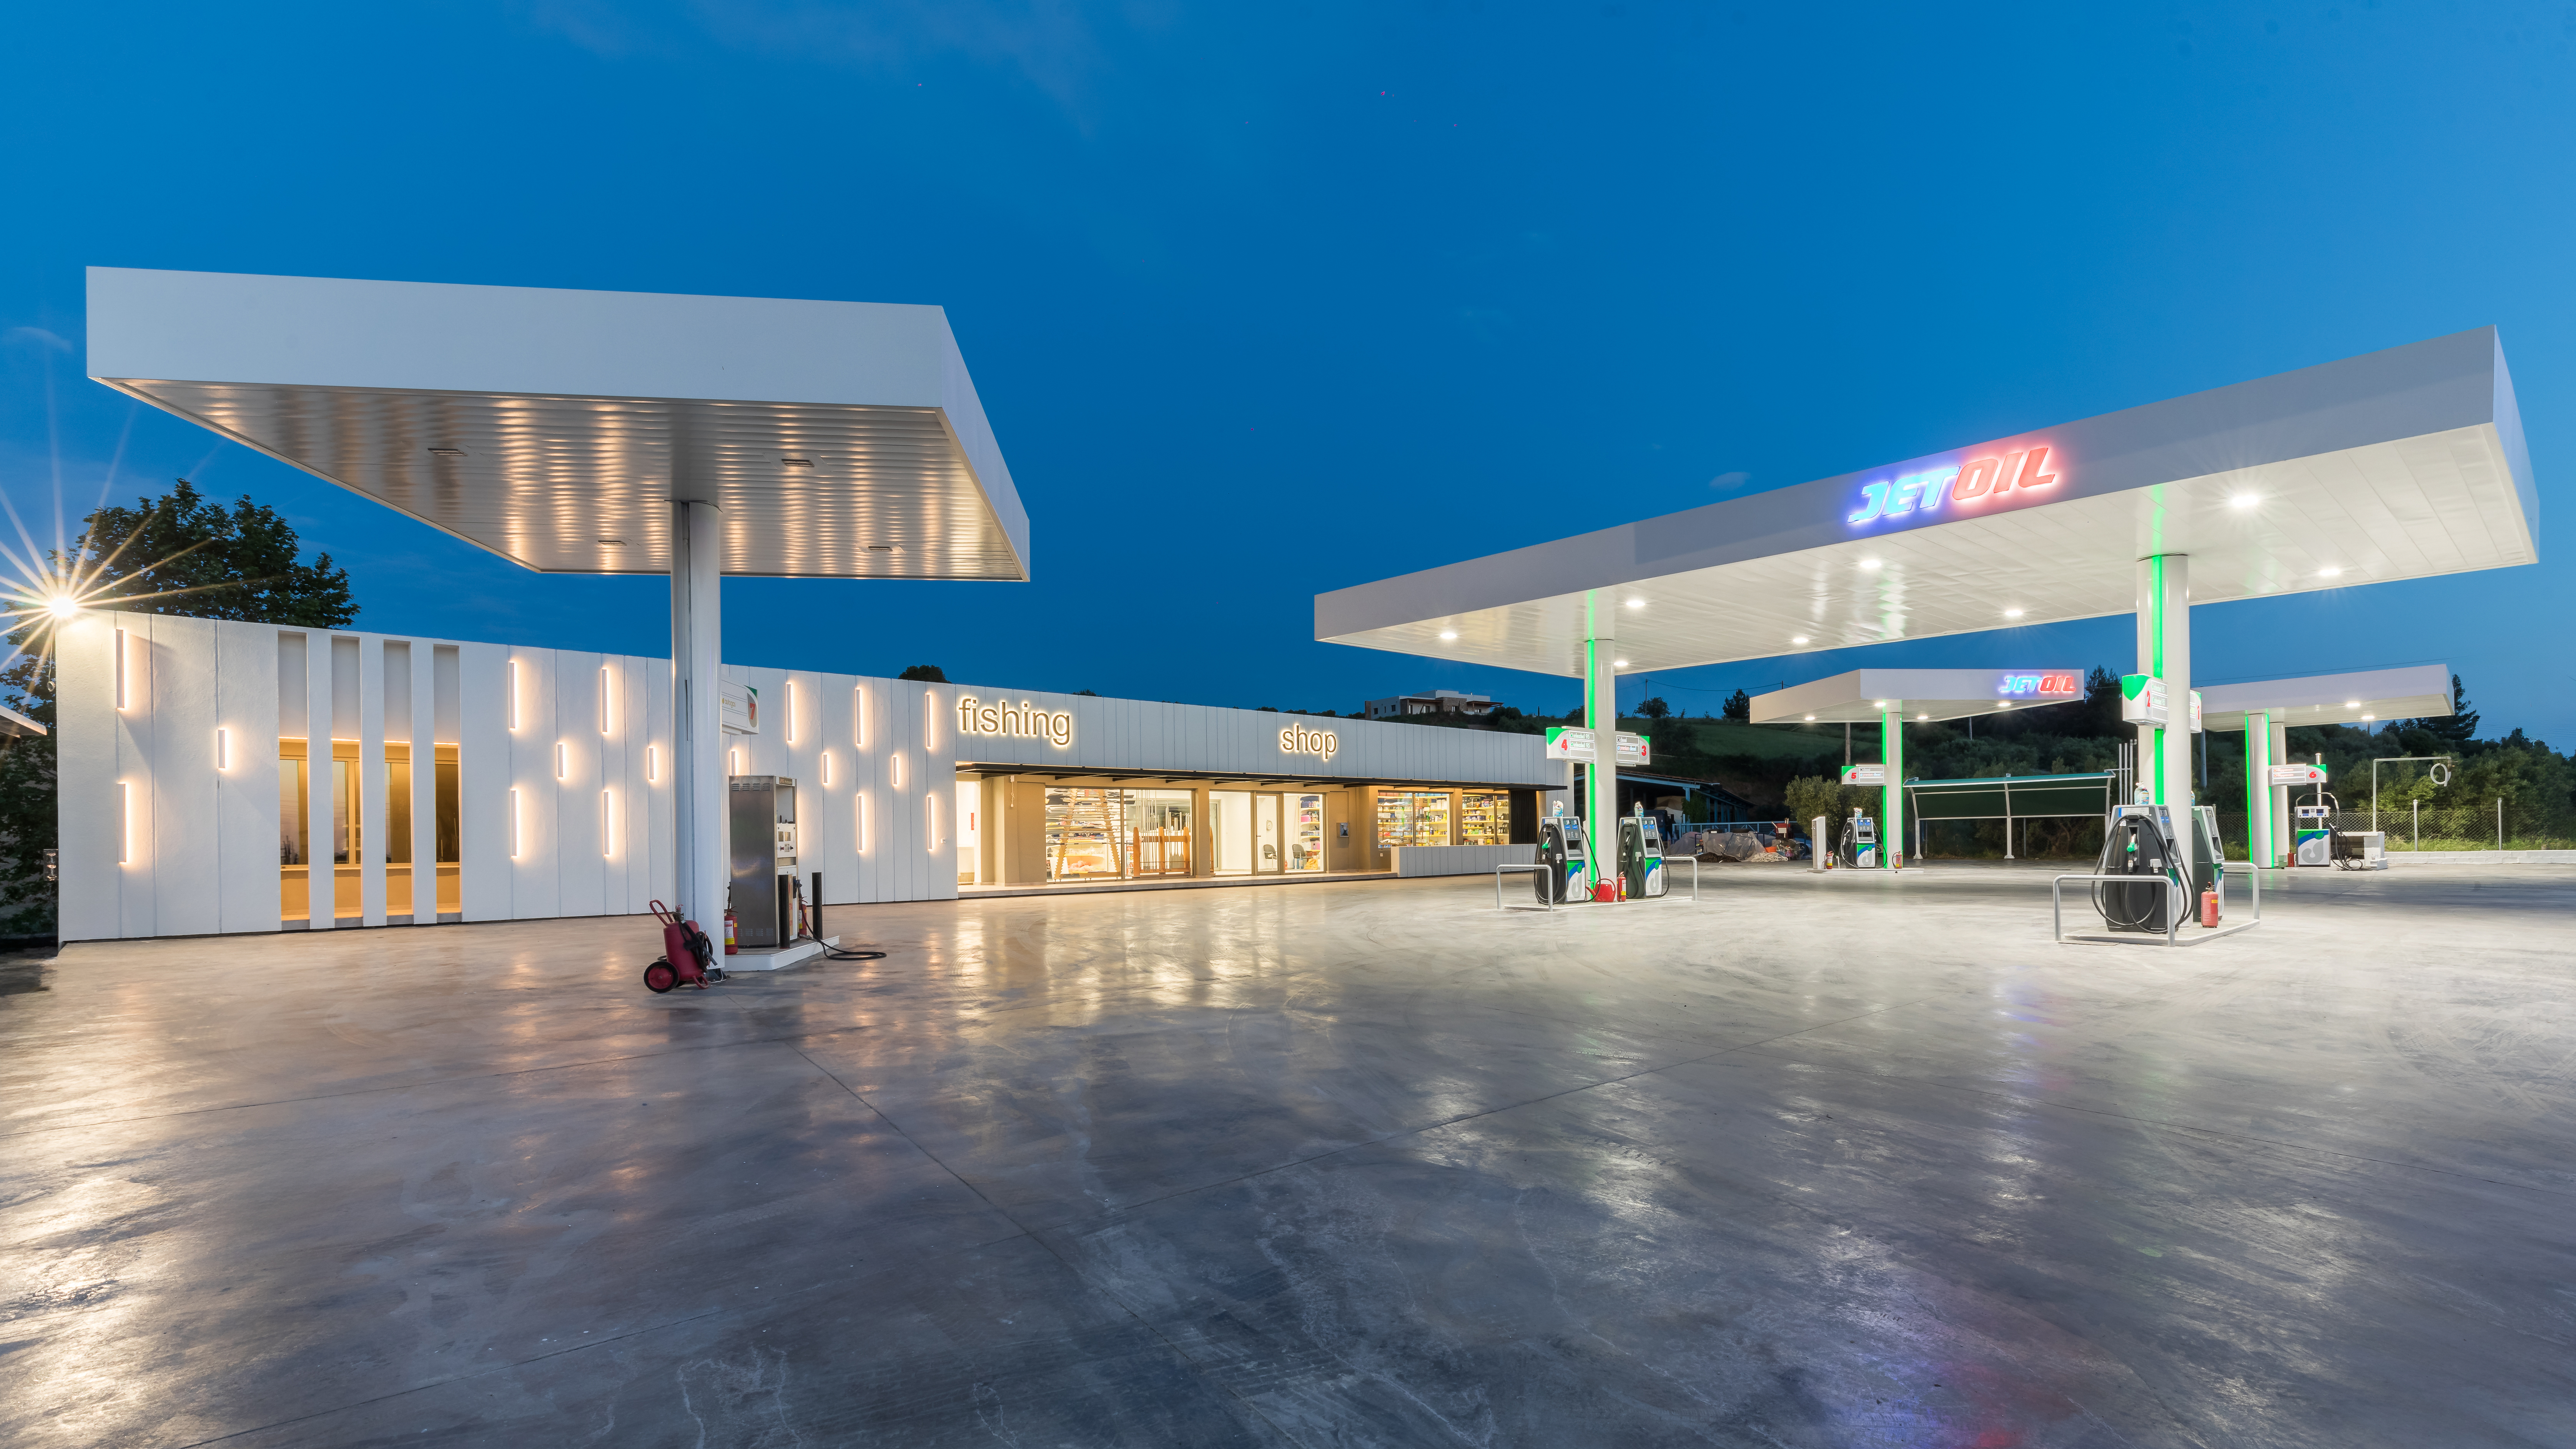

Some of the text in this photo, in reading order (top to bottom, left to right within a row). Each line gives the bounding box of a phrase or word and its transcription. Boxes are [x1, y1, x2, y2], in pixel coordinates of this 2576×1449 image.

[1847, 448, 2055, 523] JETOIL
[2000, 676, 2076, 692] JETOIL
[725, 699, 736, 708] autogas
[2147, 690, 2150, 707] 2
[750, 703, 756, 720] 7
[2197, 705, 2199, 720] 1
[958, 698, 1070, 745] fishing
[1282, 725, 1336, 759] shop
[1561, 739, 1568, 750] 4
[1641, 745, 1647, 757] 3
